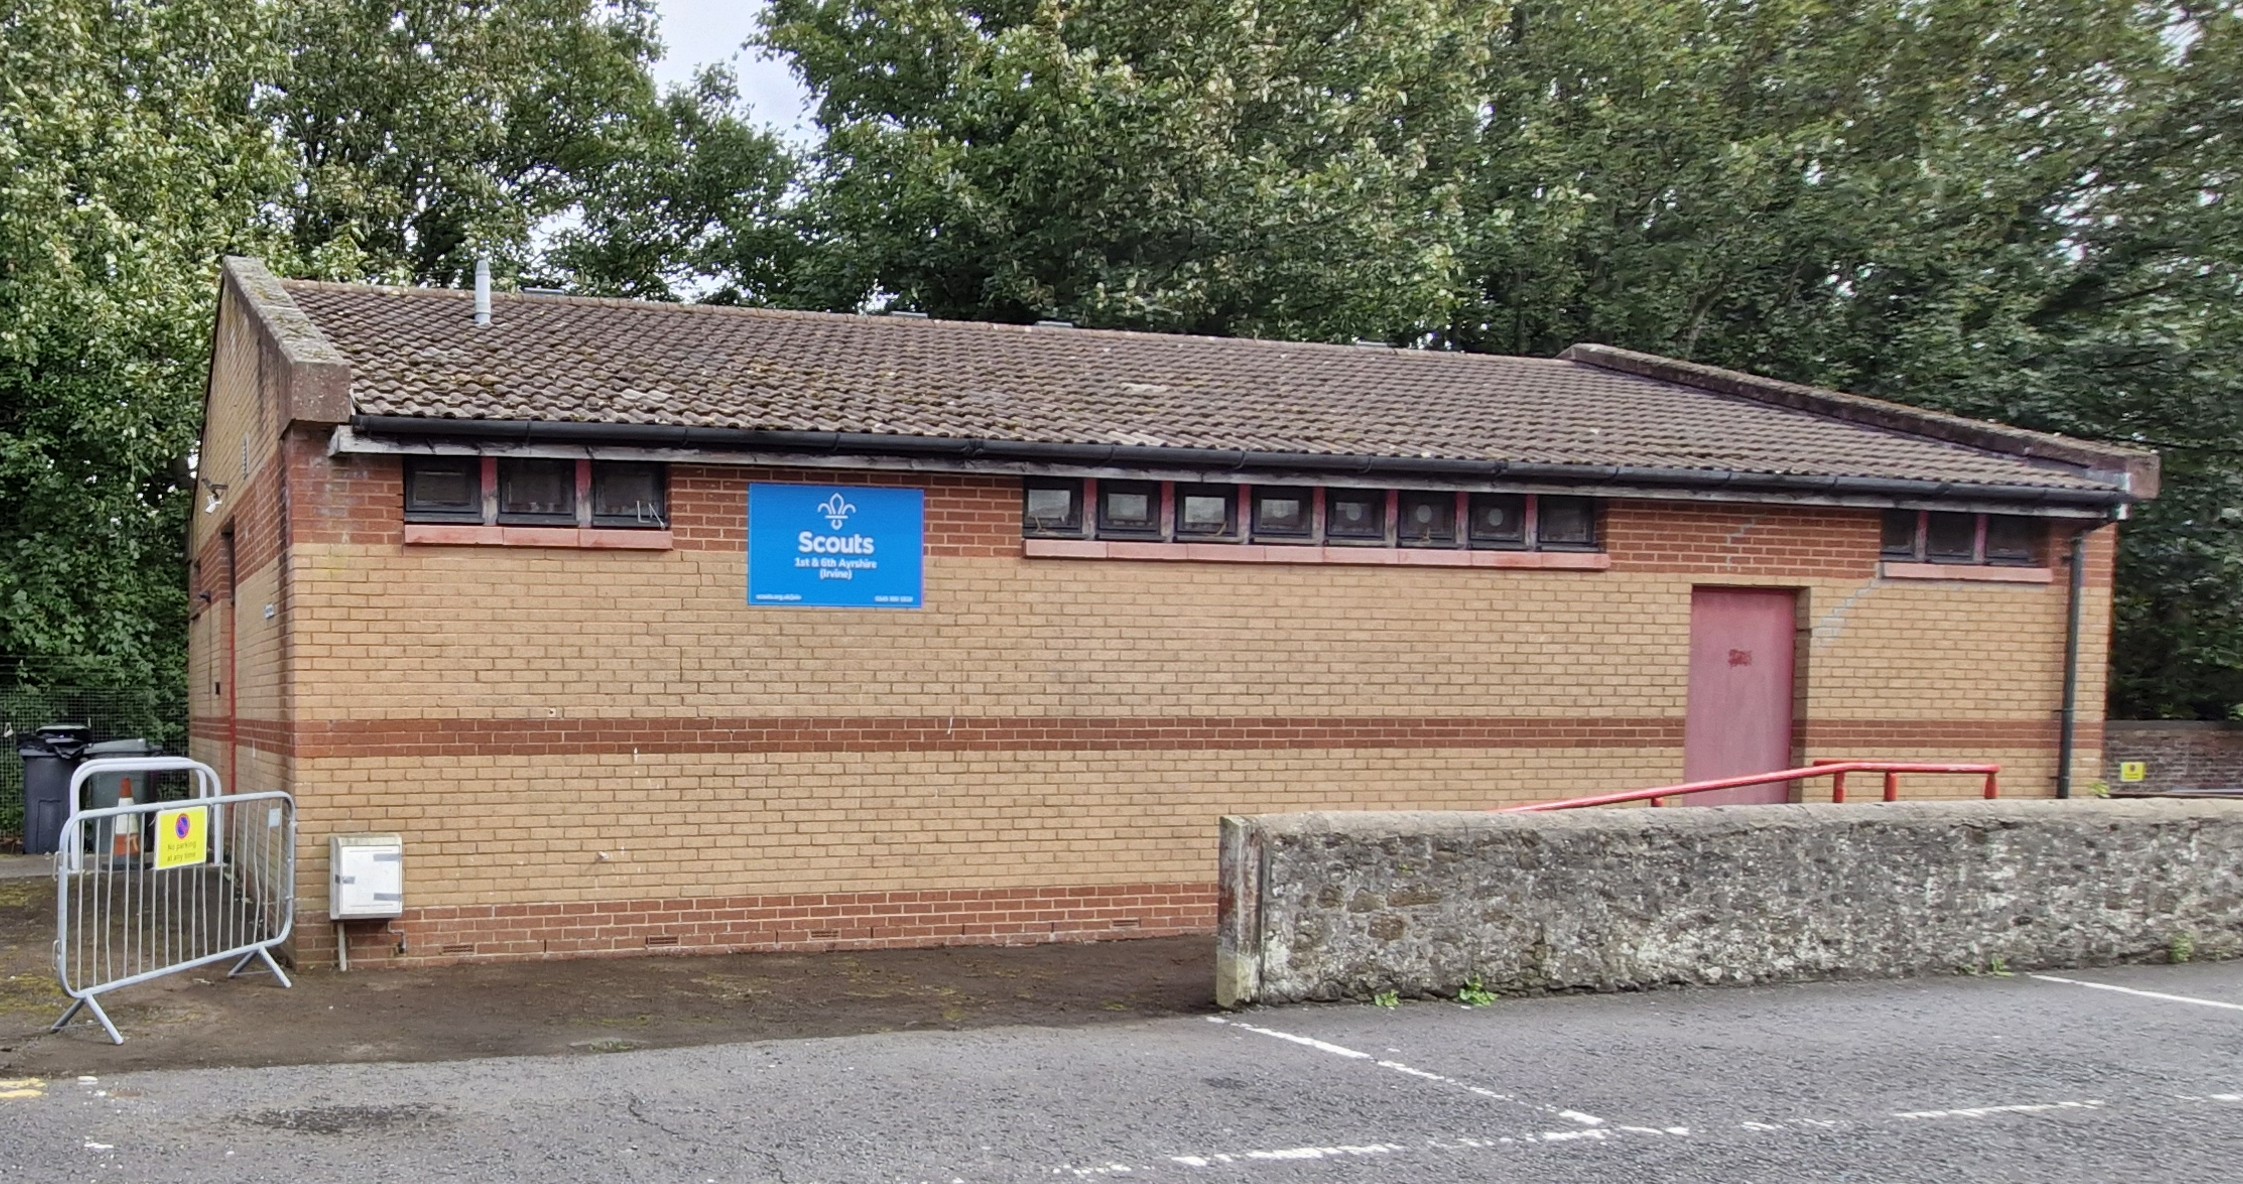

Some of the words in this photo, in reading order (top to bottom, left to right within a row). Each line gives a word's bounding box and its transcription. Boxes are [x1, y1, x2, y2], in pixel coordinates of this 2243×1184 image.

[798, 531, 875, 554] Scouts
[794, 557, 810, 568] 1st
[811, 558, 819, 568] &
[820, 557, 837, 568] 6th
[838, 558, 877, 570] Ayrshire
[819, 568, 852, 580] (Irvine)
